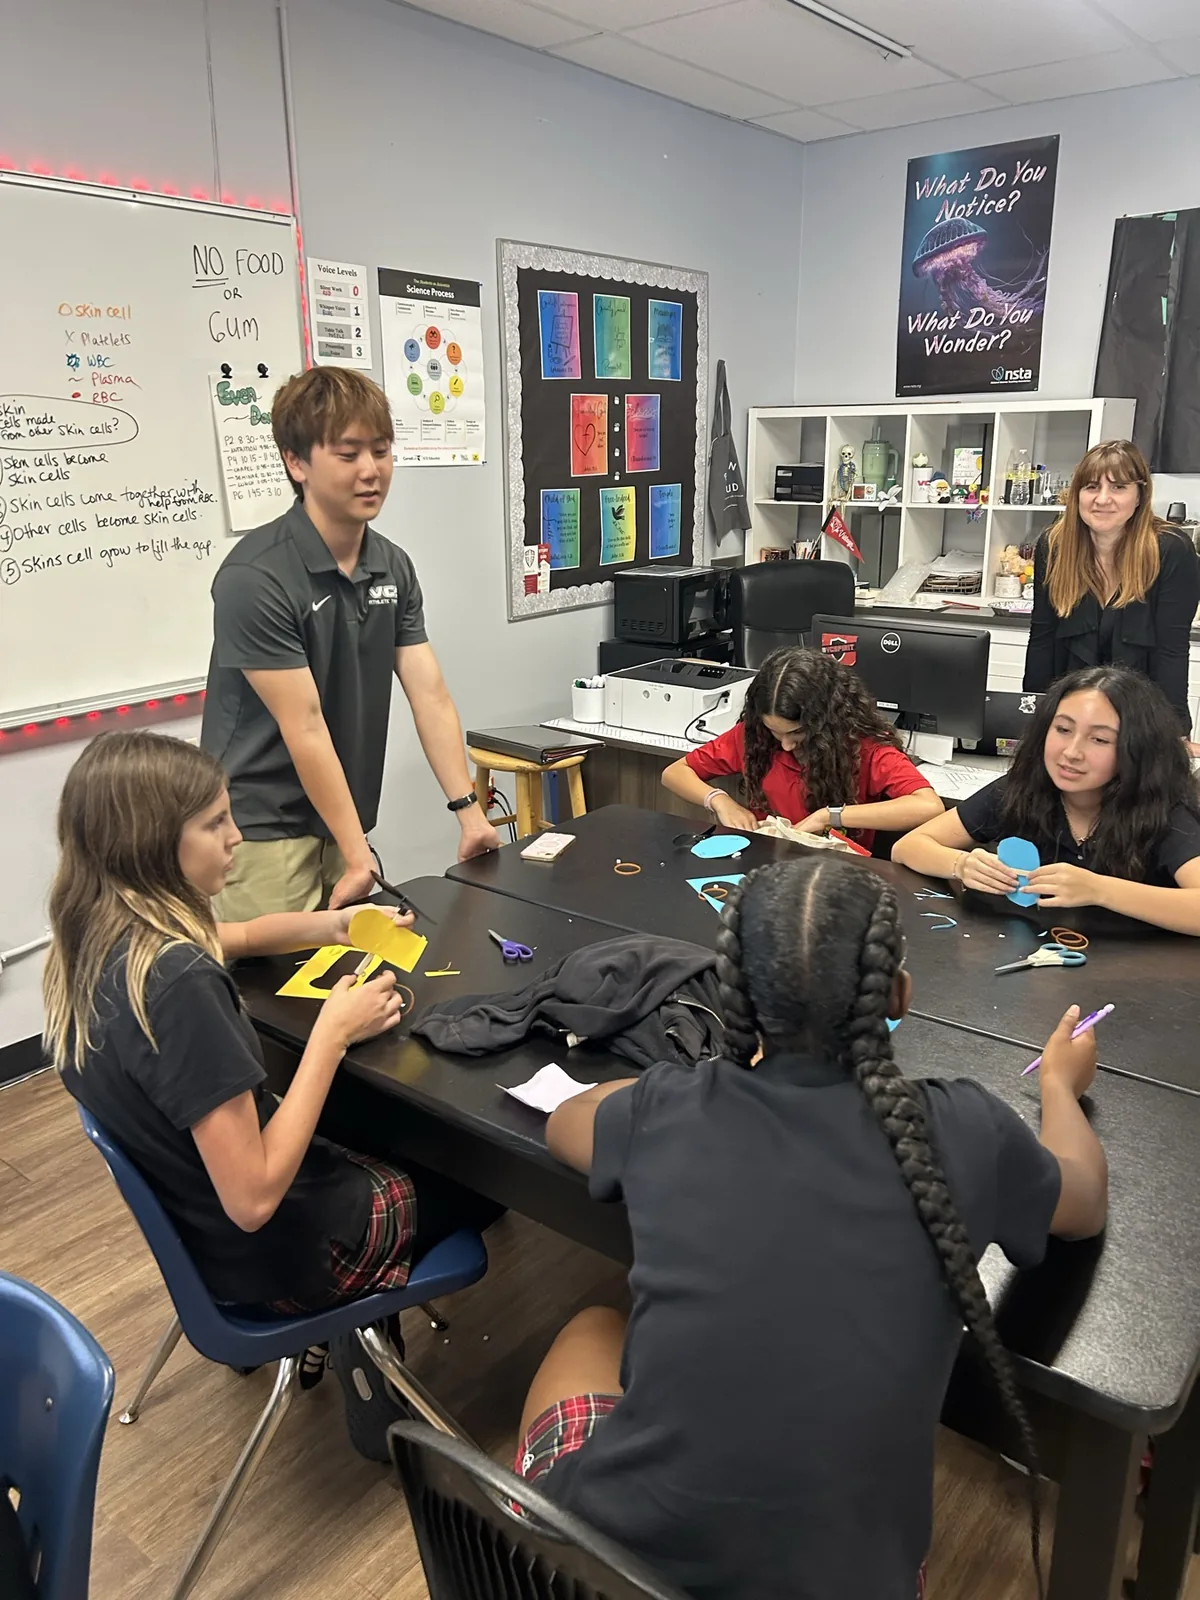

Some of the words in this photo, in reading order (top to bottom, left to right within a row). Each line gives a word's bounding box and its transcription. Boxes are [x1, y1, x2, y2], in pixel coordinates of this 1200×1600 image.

[914, 170, 971, 201] What
[974, 167, 1006, 192] Do
[1008, 158, 1048, 186] You
[934, 189, 1021, 223] Notice?
[193, 244, 224, 276] NO
[235, 248, 284, 276] FOOD
[317, 264, 336, 275] Voice
[336, 267, 358, 277] Levels
[223, 287, 243, 300] OR
[353, 285, 360, 297] 0
[406, 284, 431, 296] Science
[431, 288, 455, 299] Process
[75, 303, 102, 318] skin
[106, 304, 132, 319] cell
[354, 306, 360, 316] 1
[907, 310, 962, 335] What
[964, 306, 995, 330] Do
[999, 302, 1034, 326] You
[80, 332, 132, 347] Platelets
[355, 327, 362, 338] 2
[924, 329, 1013, 357] Wonder?
[356, 346, 363, 357] 3
[87, 354, 116, 369] WBC
[91, 371, 142, 391] Plasma
[1004, 367, 1032, 381] nsta
[92, 392, 124, 404] RBC
[216, 381, 258, 406] Even
[26, 413, 56, 426] made
[89, 416, 120, 434] cells?
[33, 452, 60, 468] cells
[63, 452, 109, 466] become
[46, 491, 76, 508] cells
[80, 492, 118, 505] come
[120, 485, 174, 509] together
[176, 479, 204, 498] with
[147, 496, 171, 510] help
[13, 522, 52, 541] Other
[58, 518, 87, 535] cells
[95, 514, 140, 528] become
[66, 546, 93, 565] cell
[100, 544, 132, 568] grow
[135, 542, 150, 554] to
[150, 538, 169, 562] fill
[170, 536, 191, 550] the
[883, 639, 899, 647] DELL
